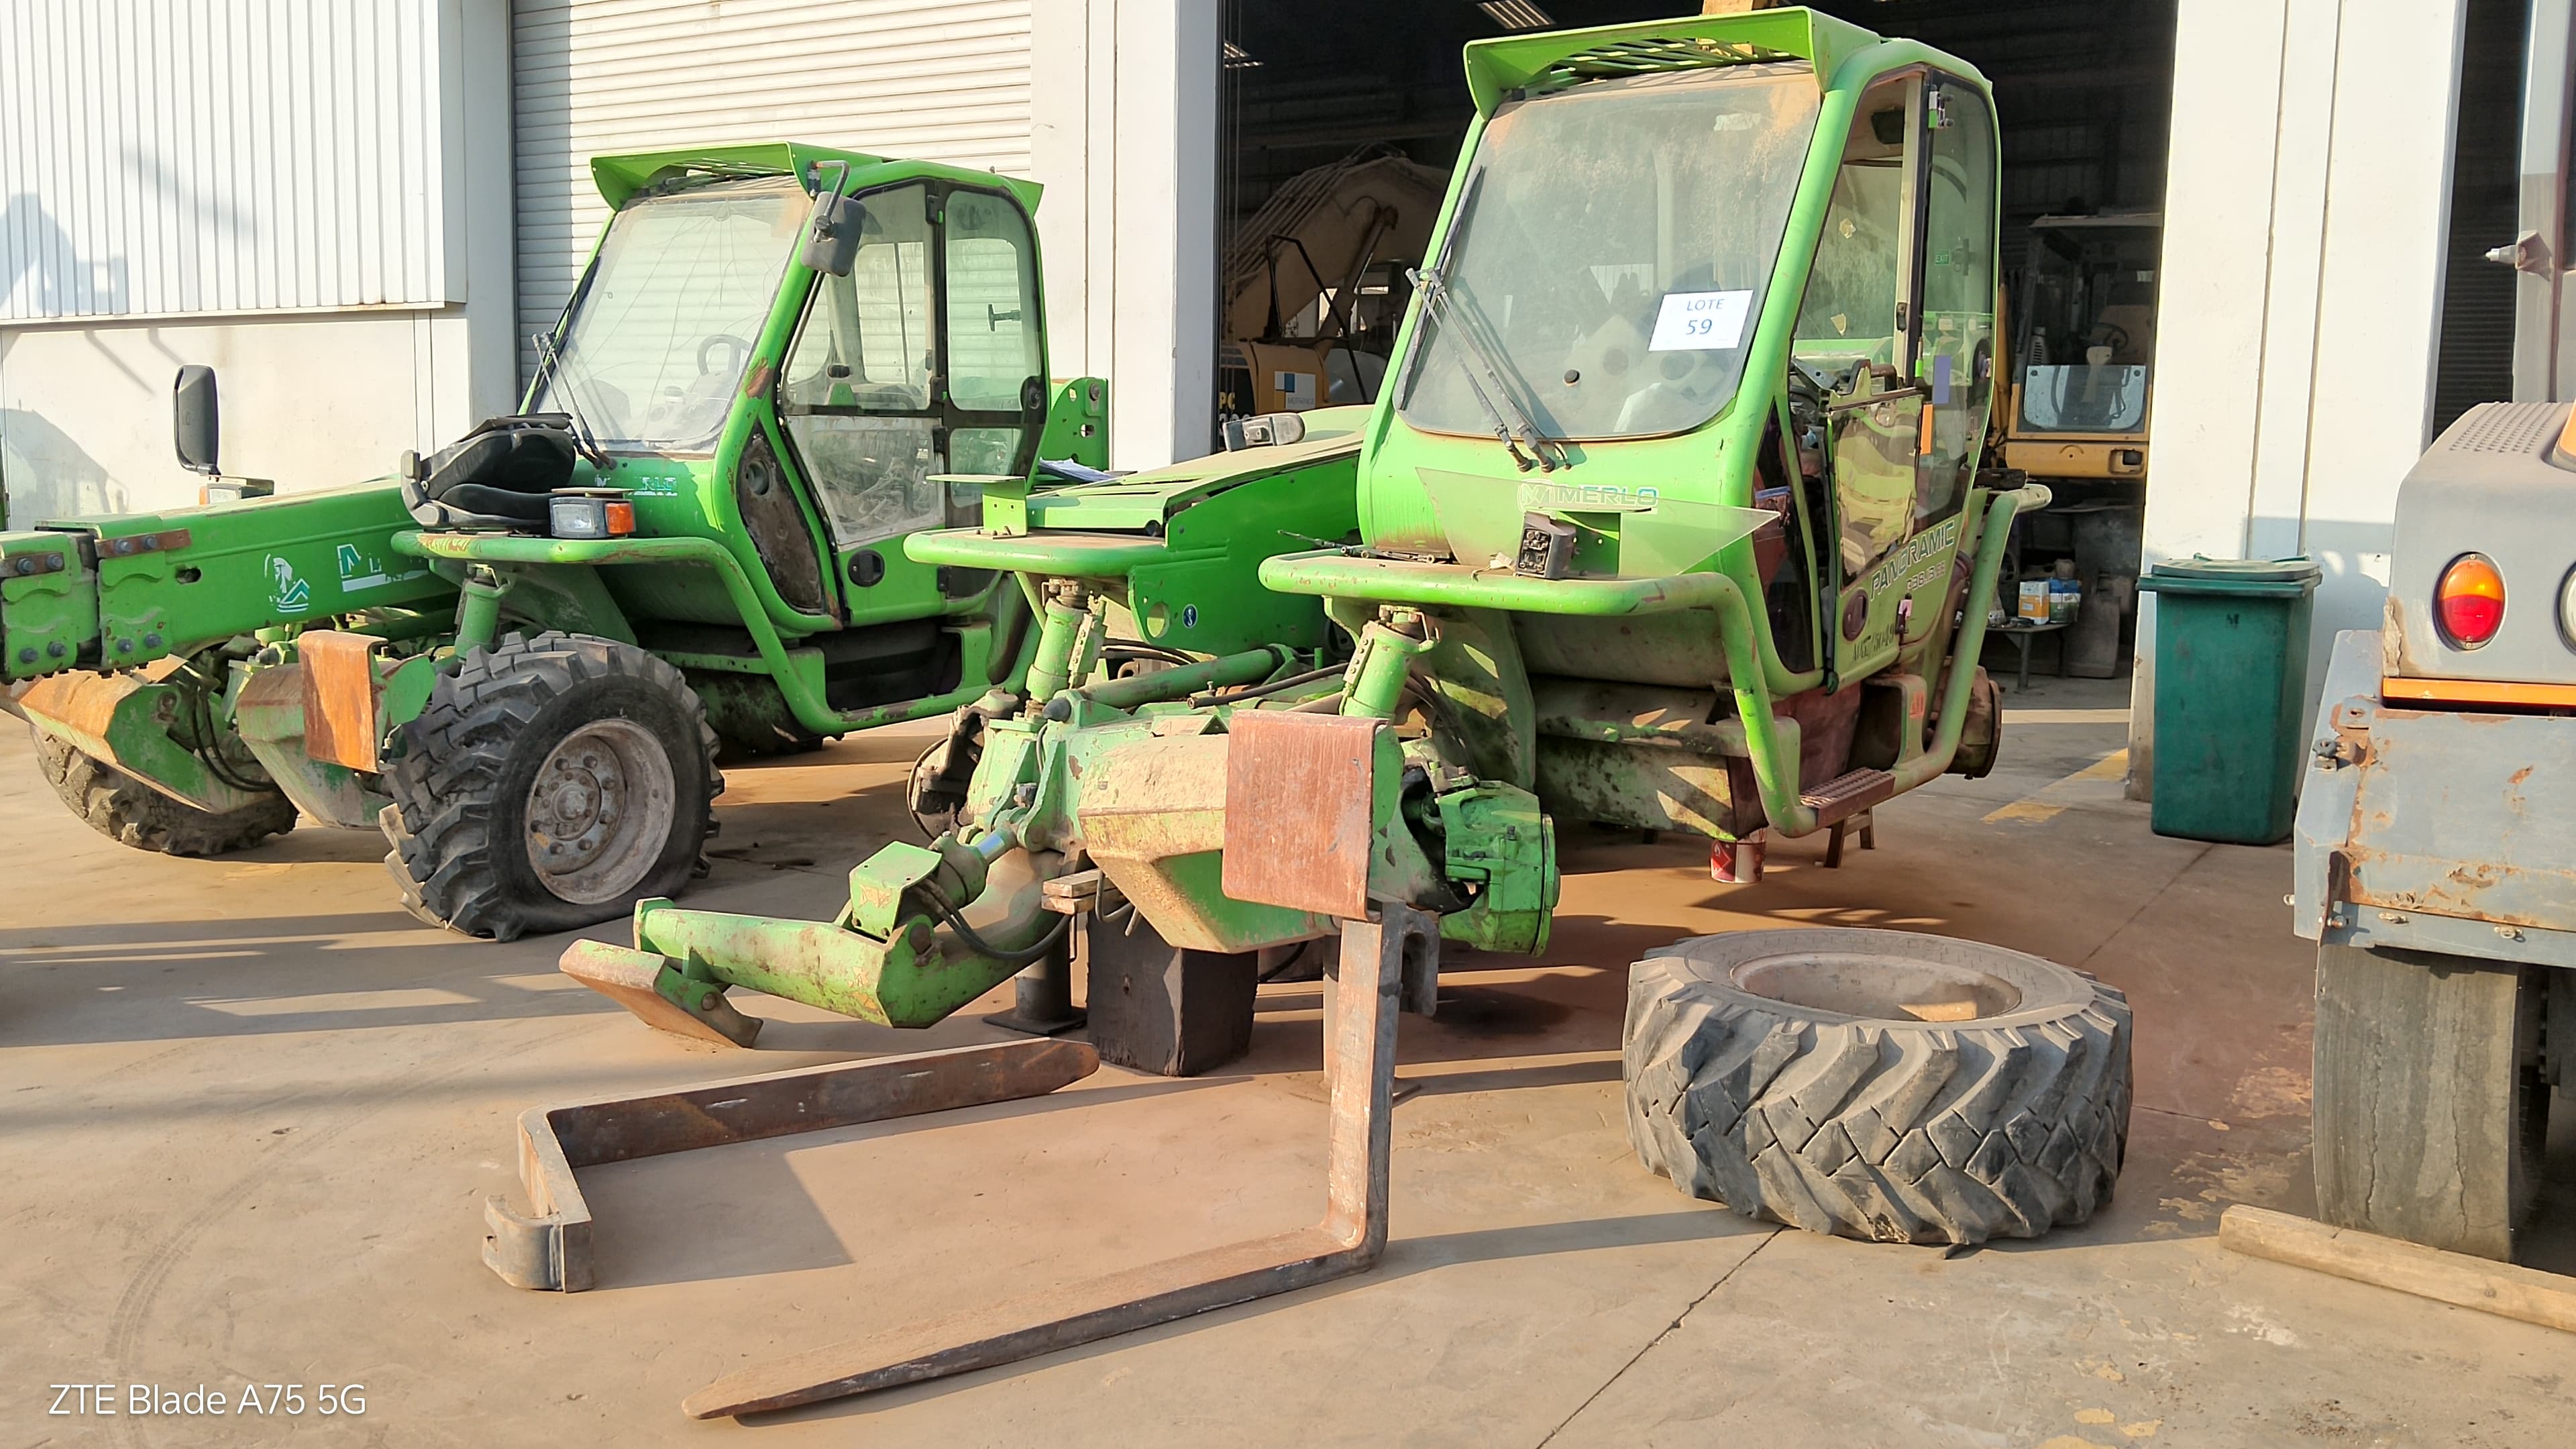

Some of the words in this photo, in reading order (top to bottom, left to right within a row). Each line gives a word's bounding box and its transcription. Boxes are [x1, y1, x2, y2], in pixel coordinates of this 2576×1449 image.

[1686, 299, 1725, 311] LOTE
[1684, 318, 1713, 335] 59
[1557, 485, 1660, 505] MERLO
